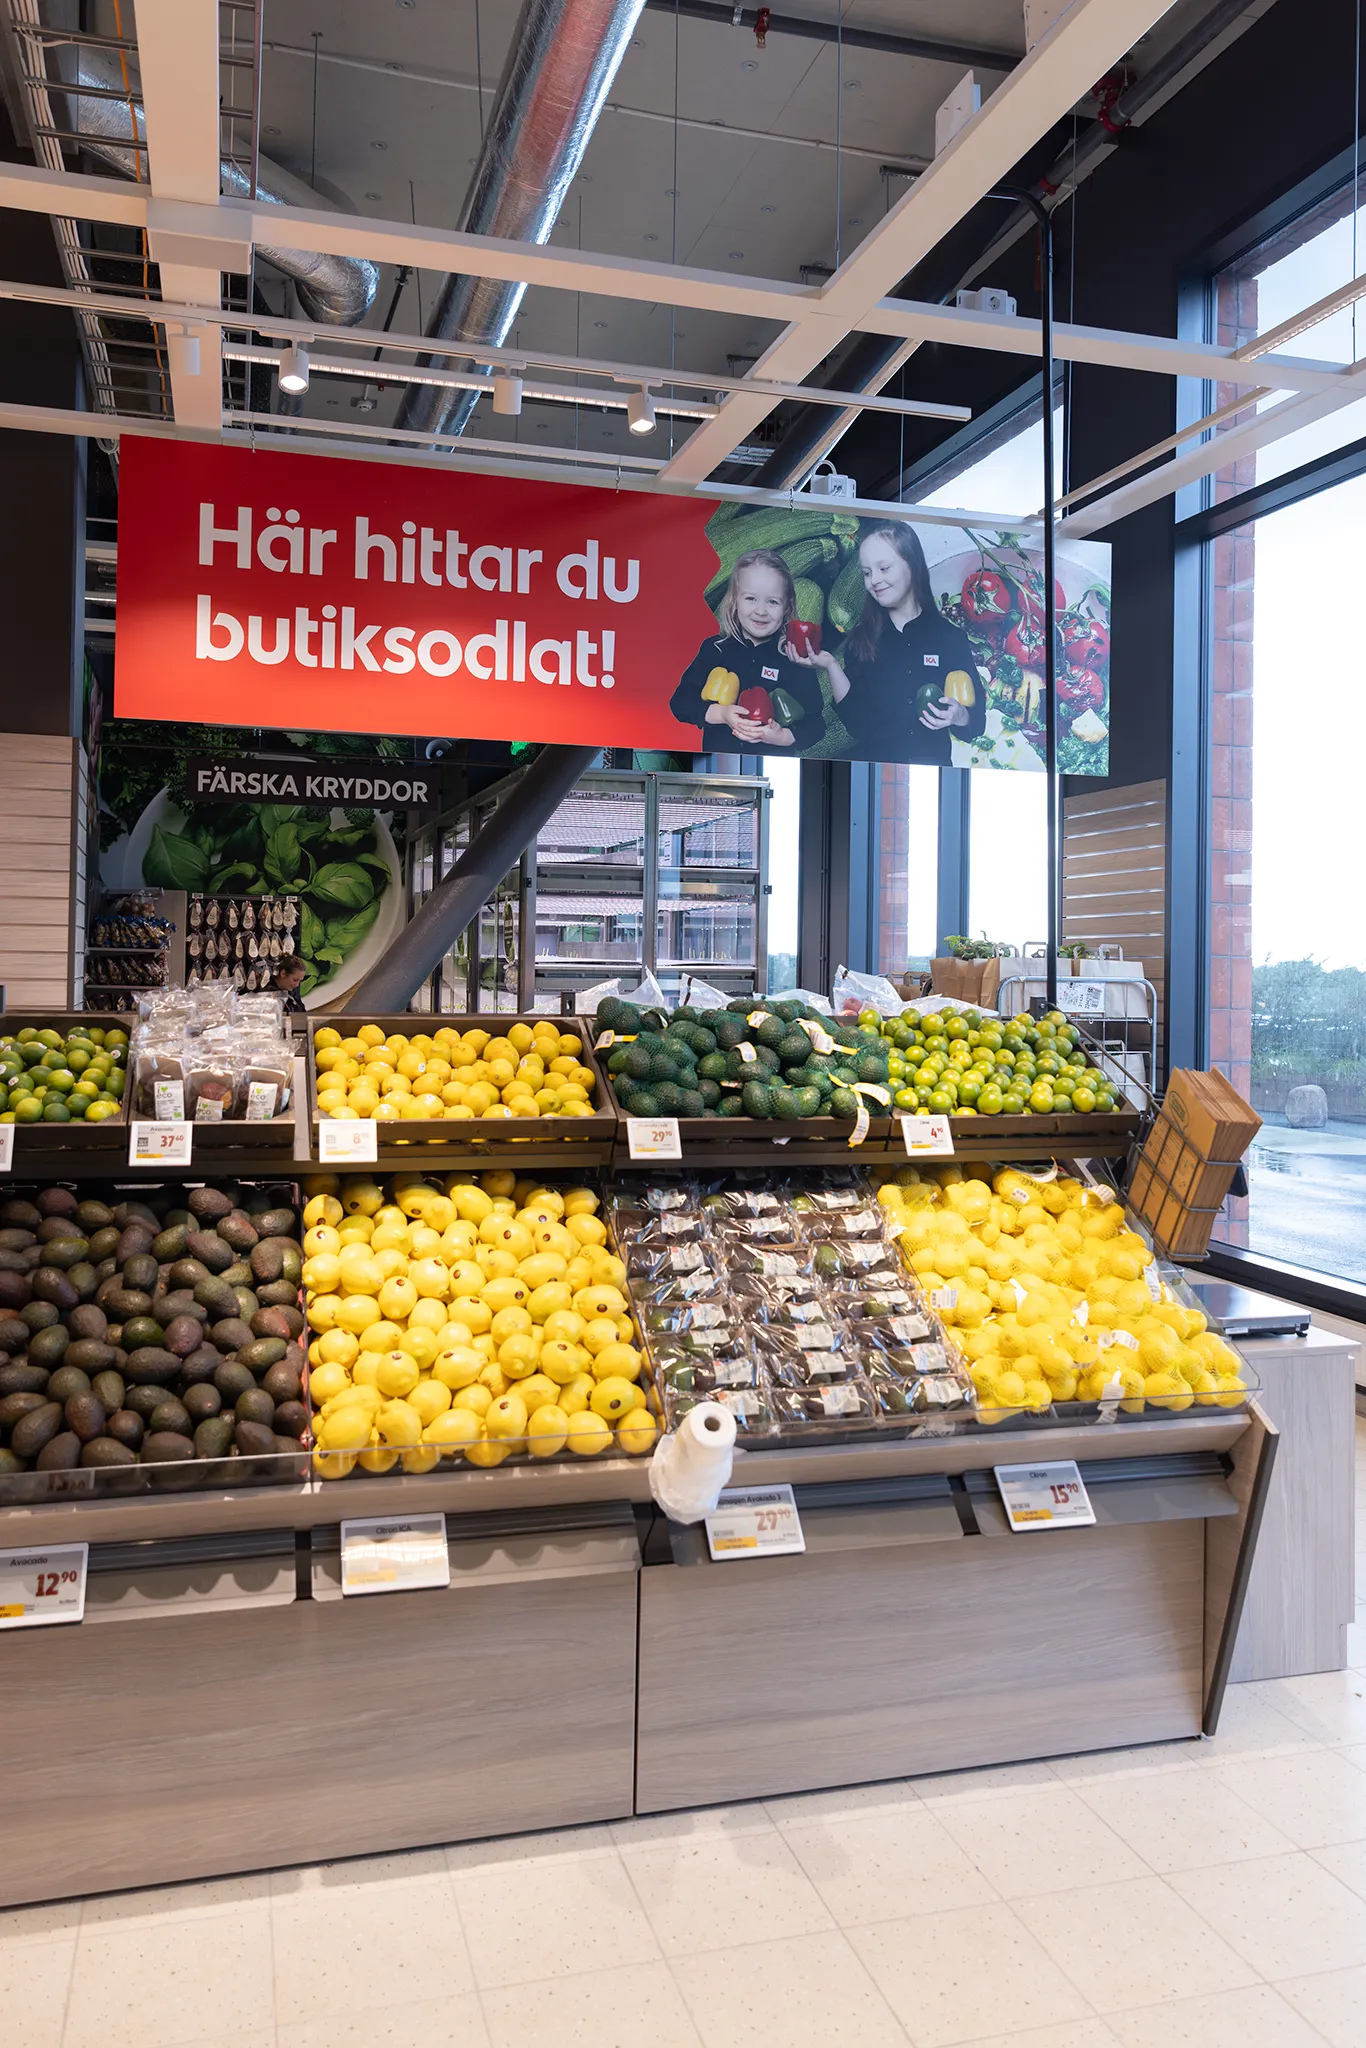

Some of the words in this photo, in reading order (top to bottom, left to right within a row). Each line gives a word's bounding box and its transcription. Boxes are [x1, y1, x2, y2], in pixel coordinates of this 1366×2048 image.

[198, 501, 336, 577] Här
[354, 515, 542, 594] hittar
[555, 539, 641, 604] du
[195, 594, 616, 690] butiksodlat!
[926, 656, 937, 664] ICA
[763, 669, 775, 678] ICA
[197, 765, 299, 797] FÄRSKA
[305, 775, 429, 803] KRYDDOR
[375, 1525, 398, 1535] Citron
[399, 1525, 412, 1533] ICA
[10, 1556, 48, 1568] Avocado
